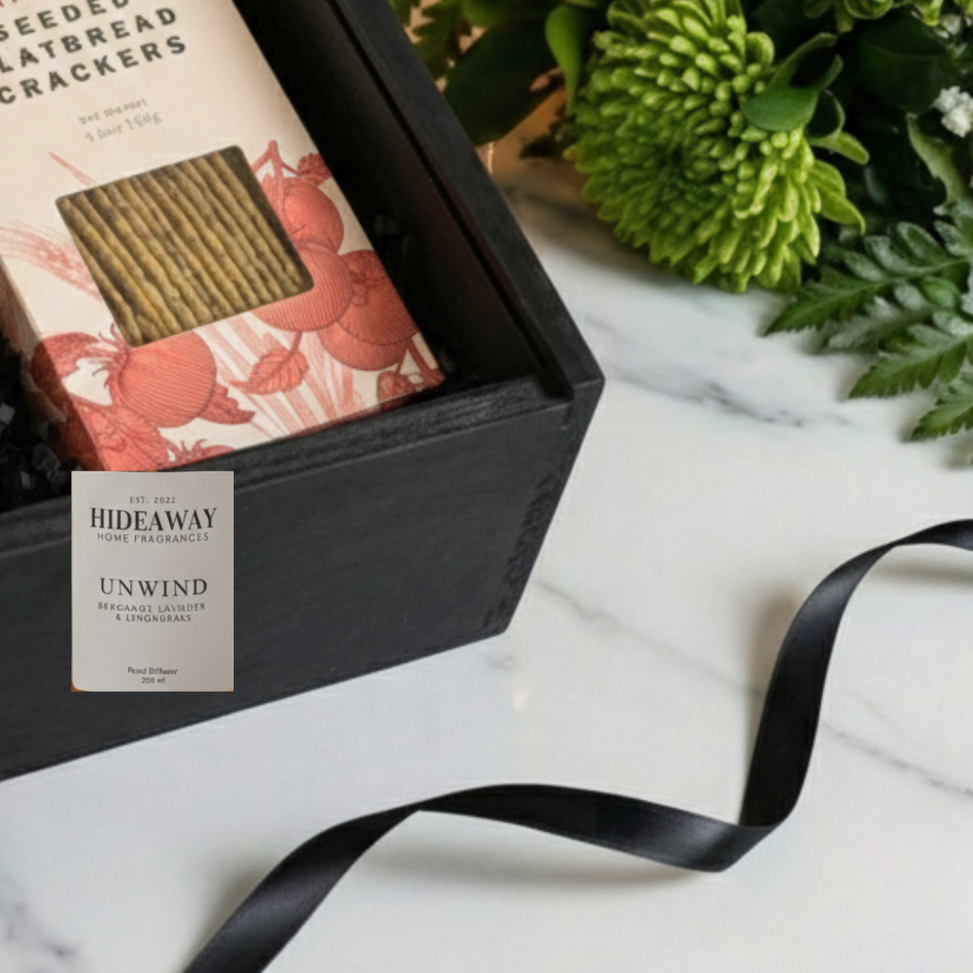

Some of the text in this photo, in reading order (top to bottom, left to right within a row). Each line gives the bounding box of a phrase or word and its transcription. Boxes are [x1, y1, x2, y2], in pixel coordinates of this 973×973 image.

[154, 496, 176, 504] 2022
[90, 507, 217, 531] HIDEAWAY
[100, 577, 207, 597] UNWIND
